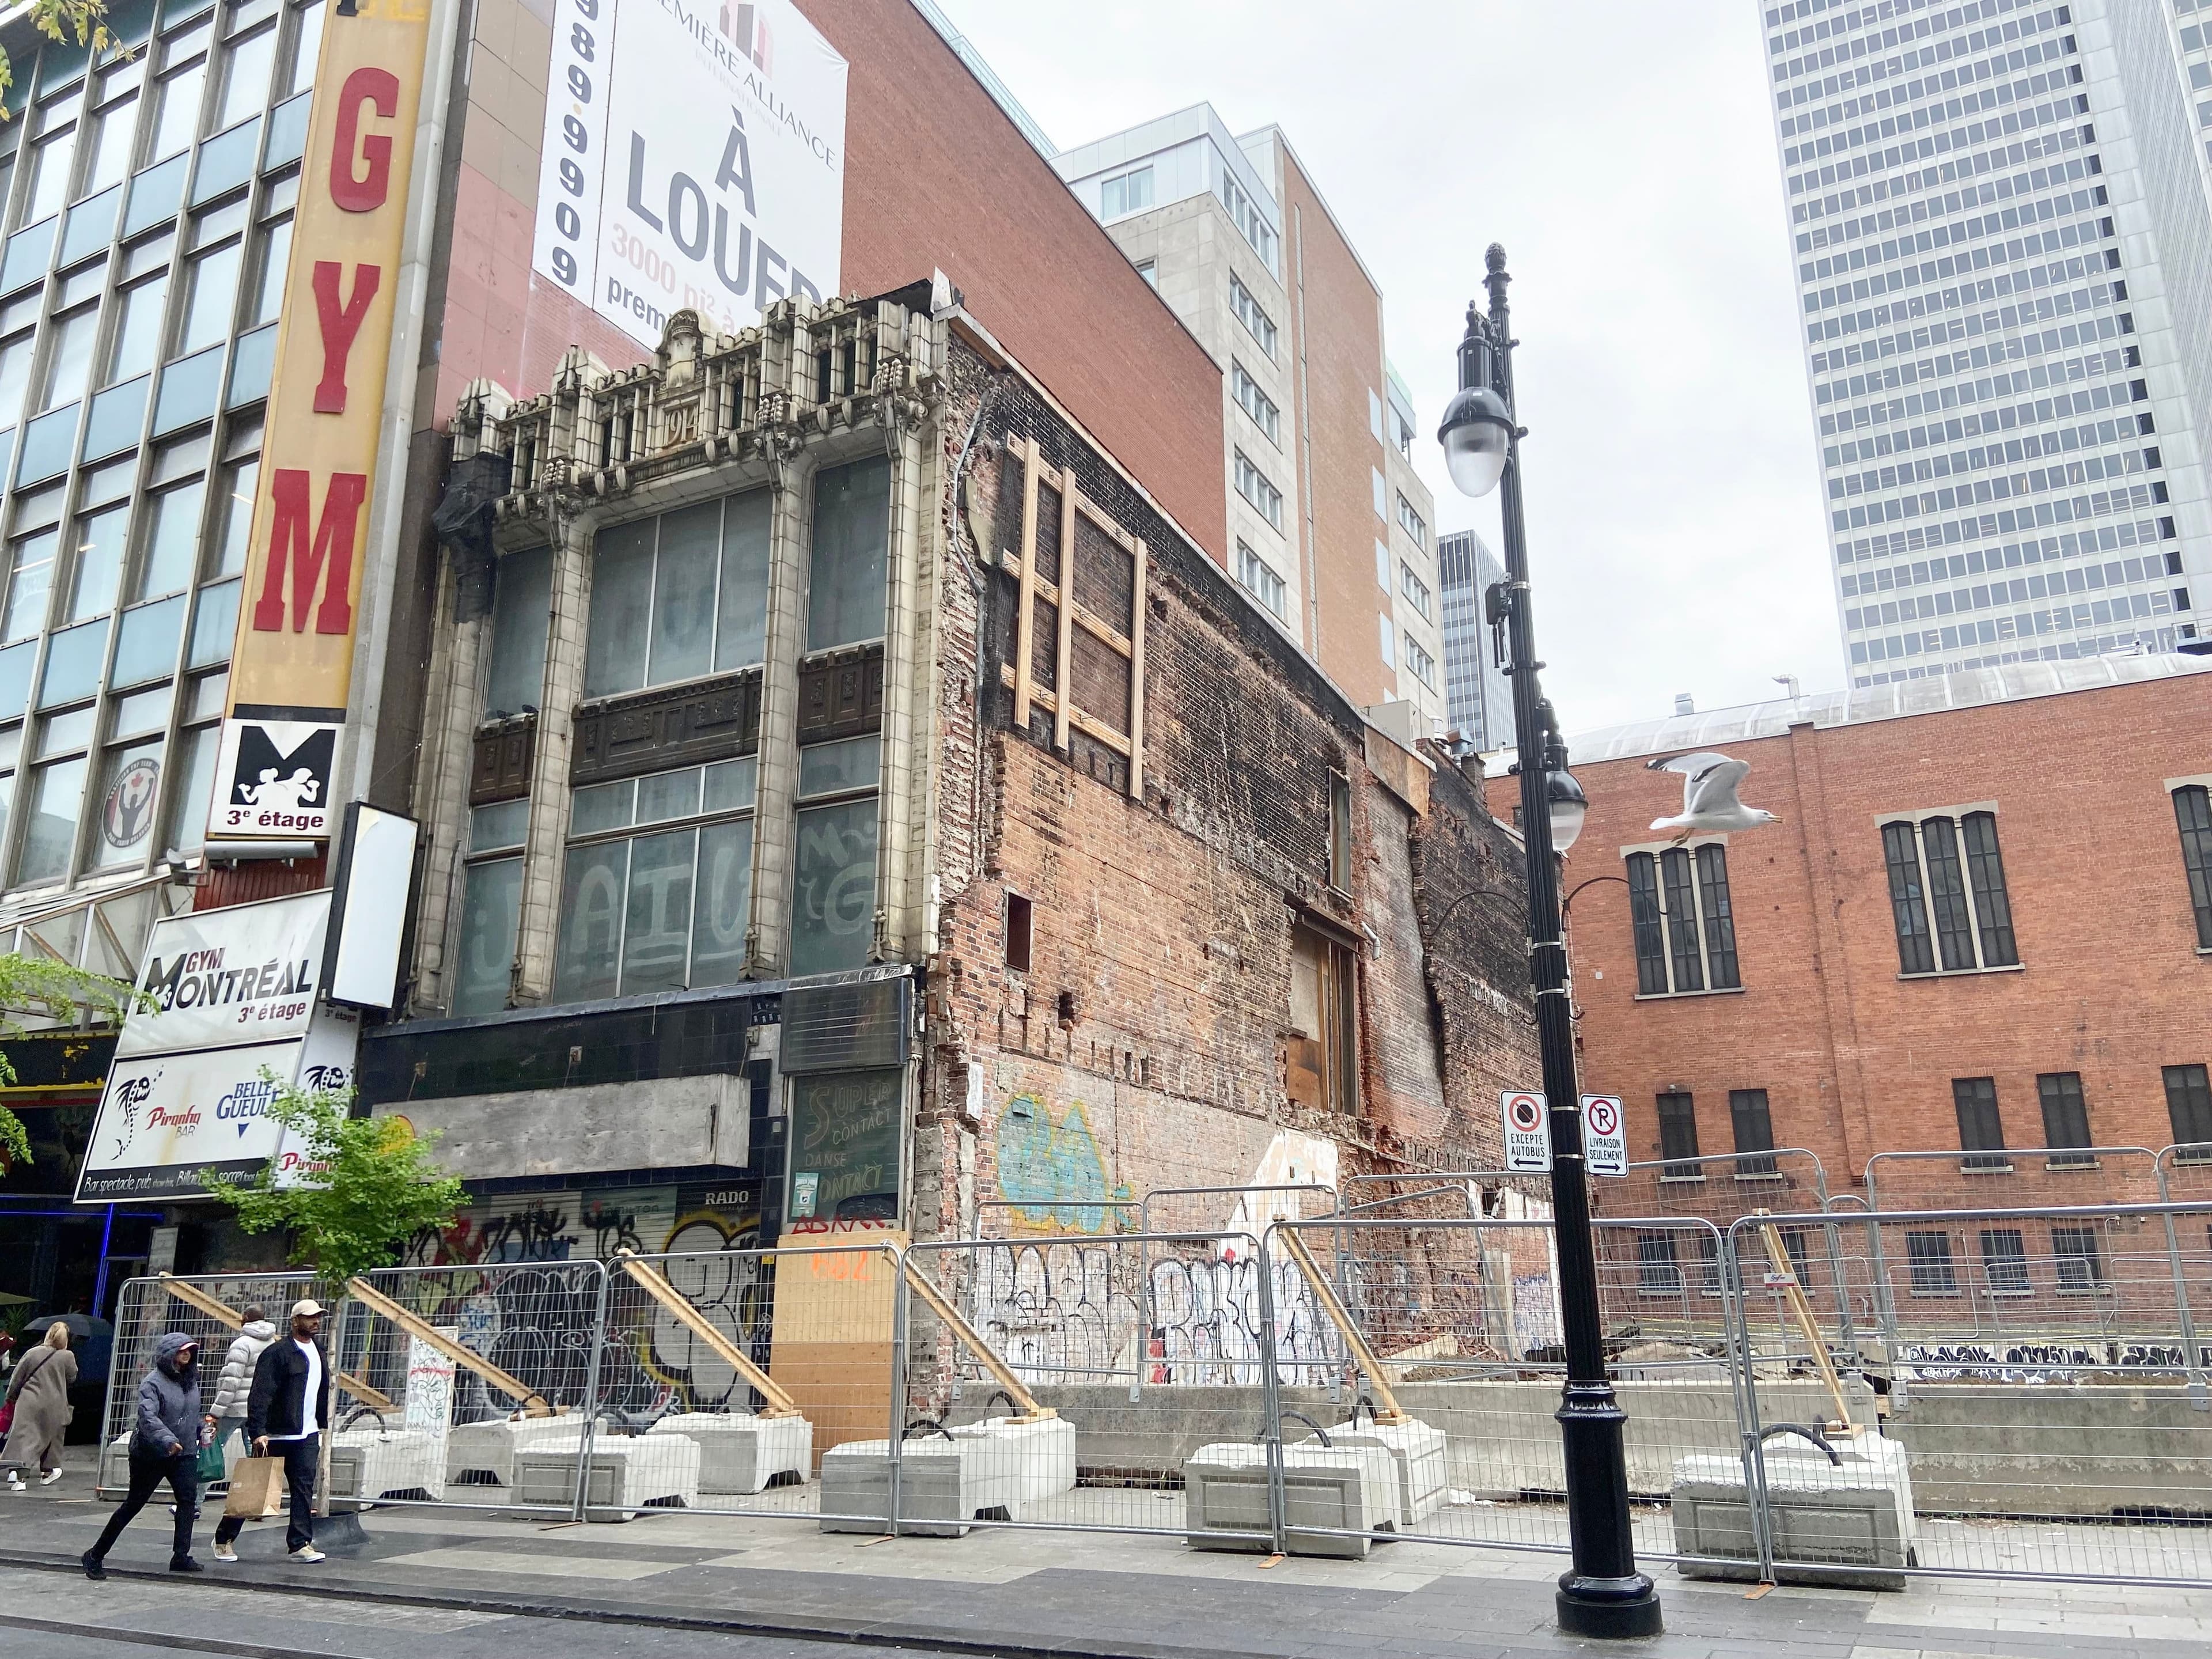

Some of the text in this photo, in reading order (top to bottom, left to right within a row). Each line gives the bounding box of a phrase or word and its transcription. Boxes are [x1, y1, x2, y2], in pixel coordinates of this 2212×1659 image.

[744, 72, 835, 172] ALLIANCE
[714, 104, 757, 218] À
[611, 222, 676, 294] 3000
[608, 276, 667, 331] prem
[253, 66, 400, 635] GYM
[258, 810, 324, 831] étage
[185, 947, 226, 974] GYM
[136, 953, 313, 1016] MONTRÉAL
[258, 1001, 306, 1022] étage
[234, 1081, 274, 1099] BELLE
[146, 1104, 201, 1130] Piranha
[175, 1125, 195, 1139] BAR
[1510, 1132, 1543, 1145] EXCEPTÉ
[1510, 1146, 1546, 1158] AUTOBUS
[1589, 1137, 1620, 1149] LIVRAISON
[805, 1152, 848, 1167] DANSE
[1589, 1149, 1623, 1161] SEULEMENT
[84, 1177, 100, 1192] Bar
[218, 1171, 244, 1184] soccer
[819, 1164, 883, 1203] ONTACT
[704, 1191, 749, 1205] RADO
